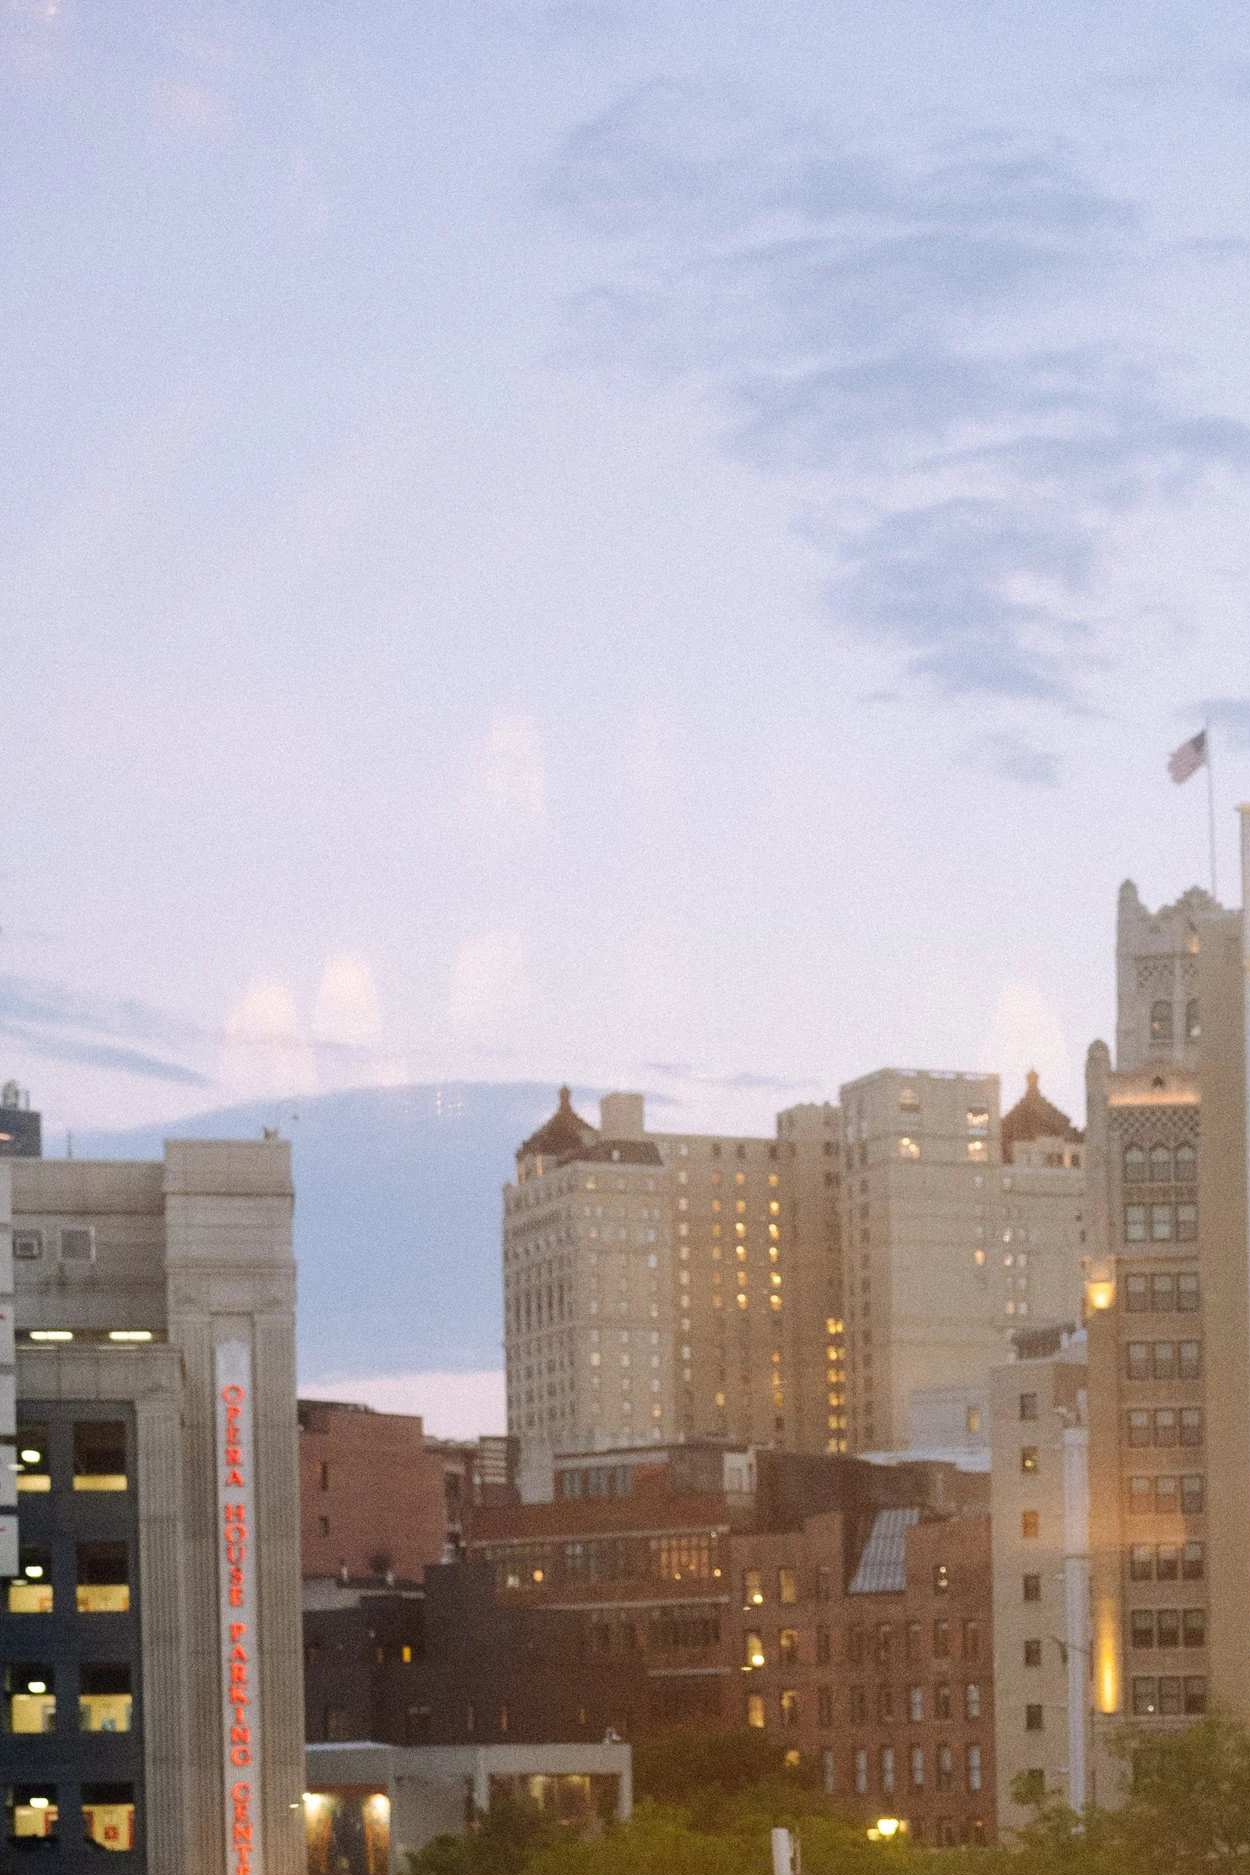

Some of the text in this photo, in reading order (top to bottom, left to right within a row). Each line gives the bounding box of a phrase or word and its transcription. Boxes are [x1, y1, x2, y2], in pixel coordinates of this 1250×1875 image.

[222, 1383, 245, 1487] OPERA
[224, 1503, 247, 1607] HOUSE
[229, 1621, 252, 1767] PARKING
